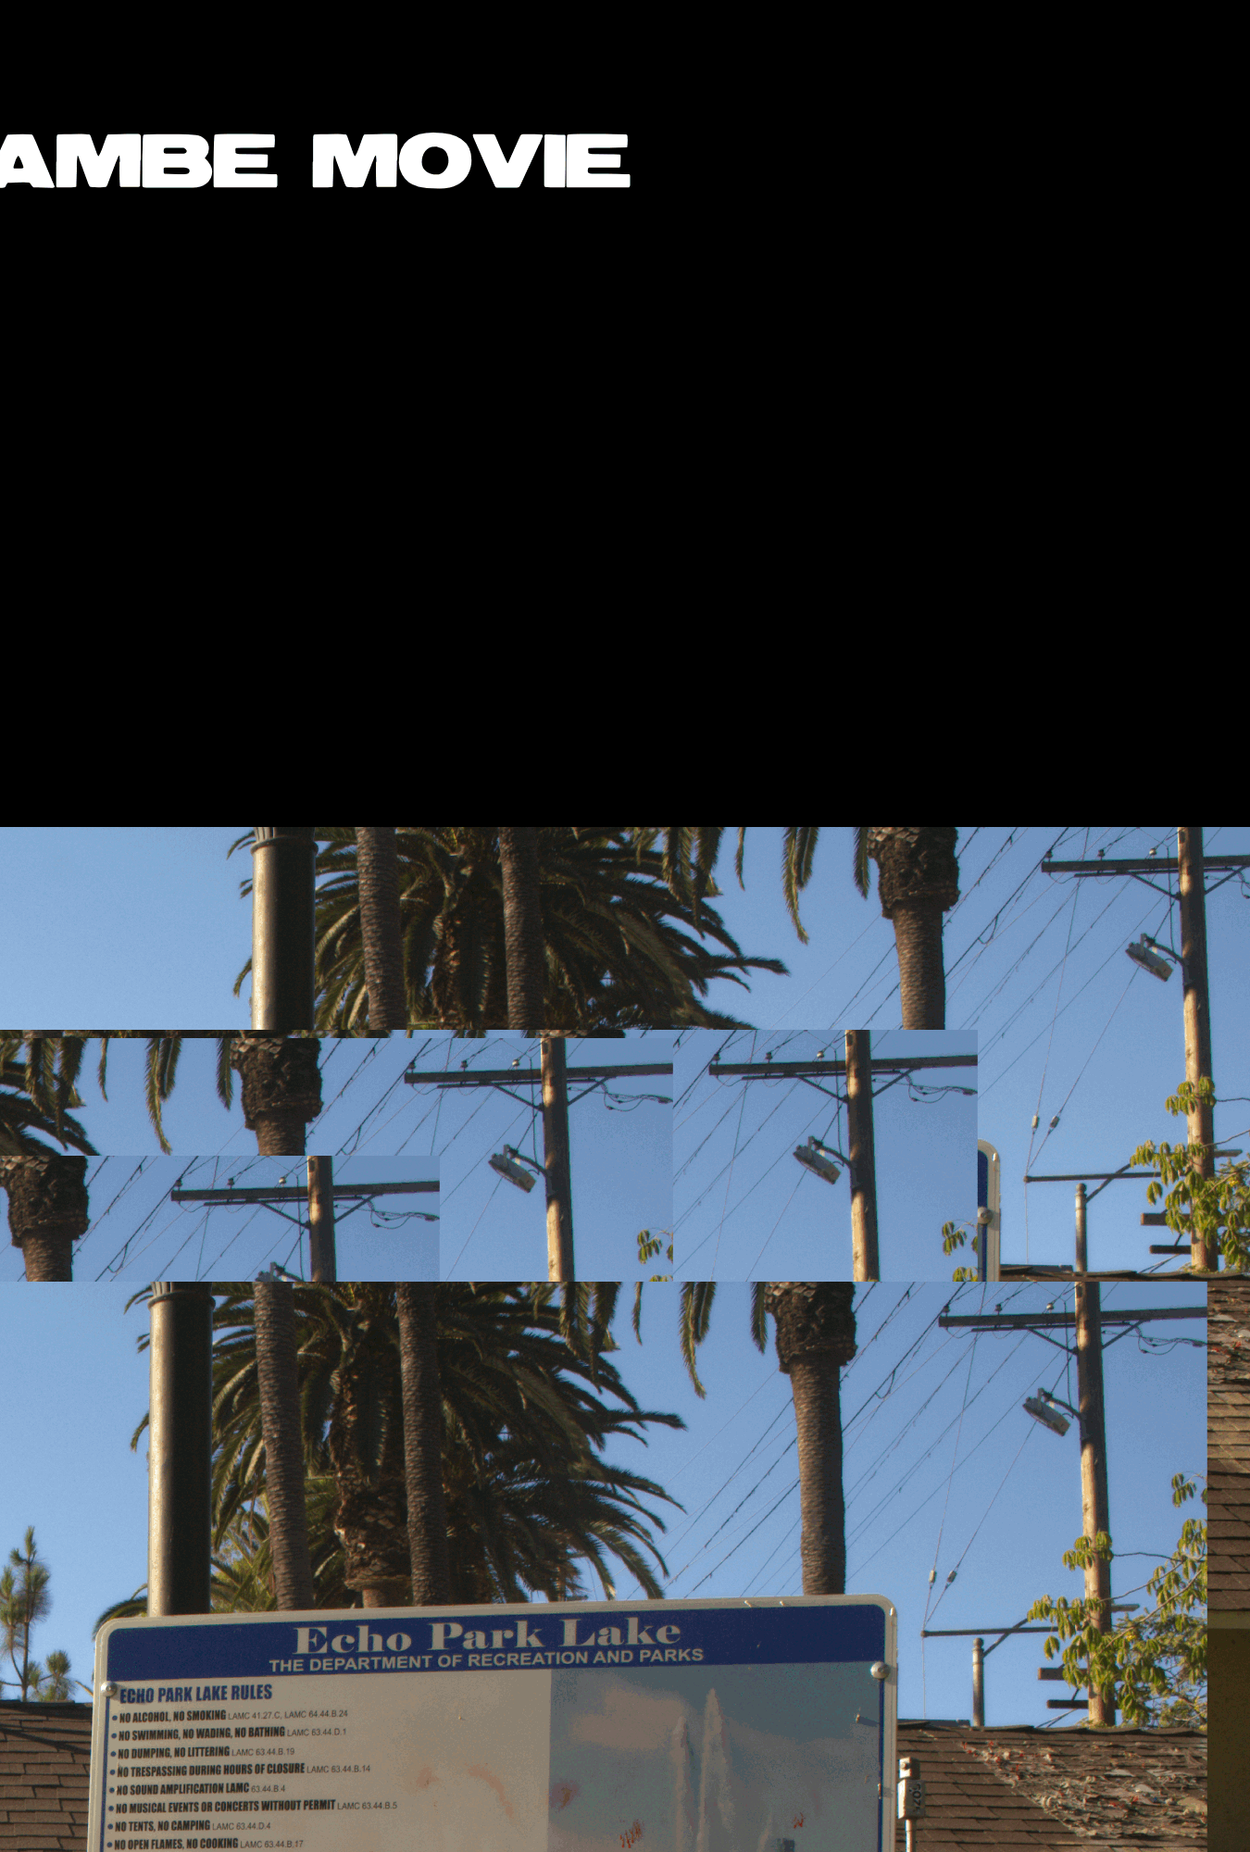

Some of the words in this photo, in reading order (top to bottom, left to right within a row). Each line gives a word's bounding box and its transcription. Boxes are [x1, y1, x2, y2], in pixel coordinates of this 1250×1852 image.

[292, 1624, 412, 1655] Echo
[426, 1619, 547, 1651] Park
[557, 1615, 681, 1647] Lake
[269, 1659, 303, 1672] THE
[309, 1656, 432, 1671] DEPARTMENT
[437, 1655, 460, 1668] OF
[467, 1651, 589, 1667] RECREATION
[592, 1649, 633, 1664] AND
[639, 1648, 704, 1663] PARKS
[119, 1686, 154, 1702] ECHO
[157, 1686, 192, 1702] PARK
[195, 1685, 228, 1701] LAKE
[230, 1684, 273, 1700] RULES
[119, 1711, 131, 1722] NO
[132, 1711, 171, 1722] ALCOHOL,
[172, 1710, 185, 1721] NO
[186, 1709, 226, 1720] SMOKING
[118, 1729, 130, 1739] NO
[131, 1728, 181, 1740] SWIMMING,
[182, 1728, 194, 1738] NO
[195, 1727, 234, 1739] WADING,
[234, 1727, 247, 1737] NO
[247, 1726, 286, 1737] BATHING
[117, 1747, 129, 1758] NO
[130, 1747, 173, 1758] DUMPING,
[173, 1746, 186, 1757] NO
[187, 1746, 230, 1756] LITTERING
[117, 1765, 129, 1776] NO
[130, 1764, 187, 1776] TRESPASSING
[188, 1764, 222, 1775] DURING
[222, 1763, 253, 1774] HOURS
[254, 1763, 265, 1774] OF
[266, 1762, 305, 1774] CLOSURE
[116, 1784, 128, 1794] NO
[129, 1783, 159, 1794] SOUND
[160, 1782, 224, 1794] AMPLIFICATION
[225, 1782, 250, 1793] LAMC
[114, 1820, 127, 1831] NO
[128, 1820, 156, 1832] TENTS,
[157, 1820, 170, 1830] NO
[170, 1819, 211, 1830] CAMPING
[113, 1839, 126, 1849] NO
[127, 1838, 149, 1849] OPEN
[150, 1838, 185, 1850] FLAMES,
[185, 1838, 198, 1848] NO
[199, 1837, 239, 1848] COOKING
